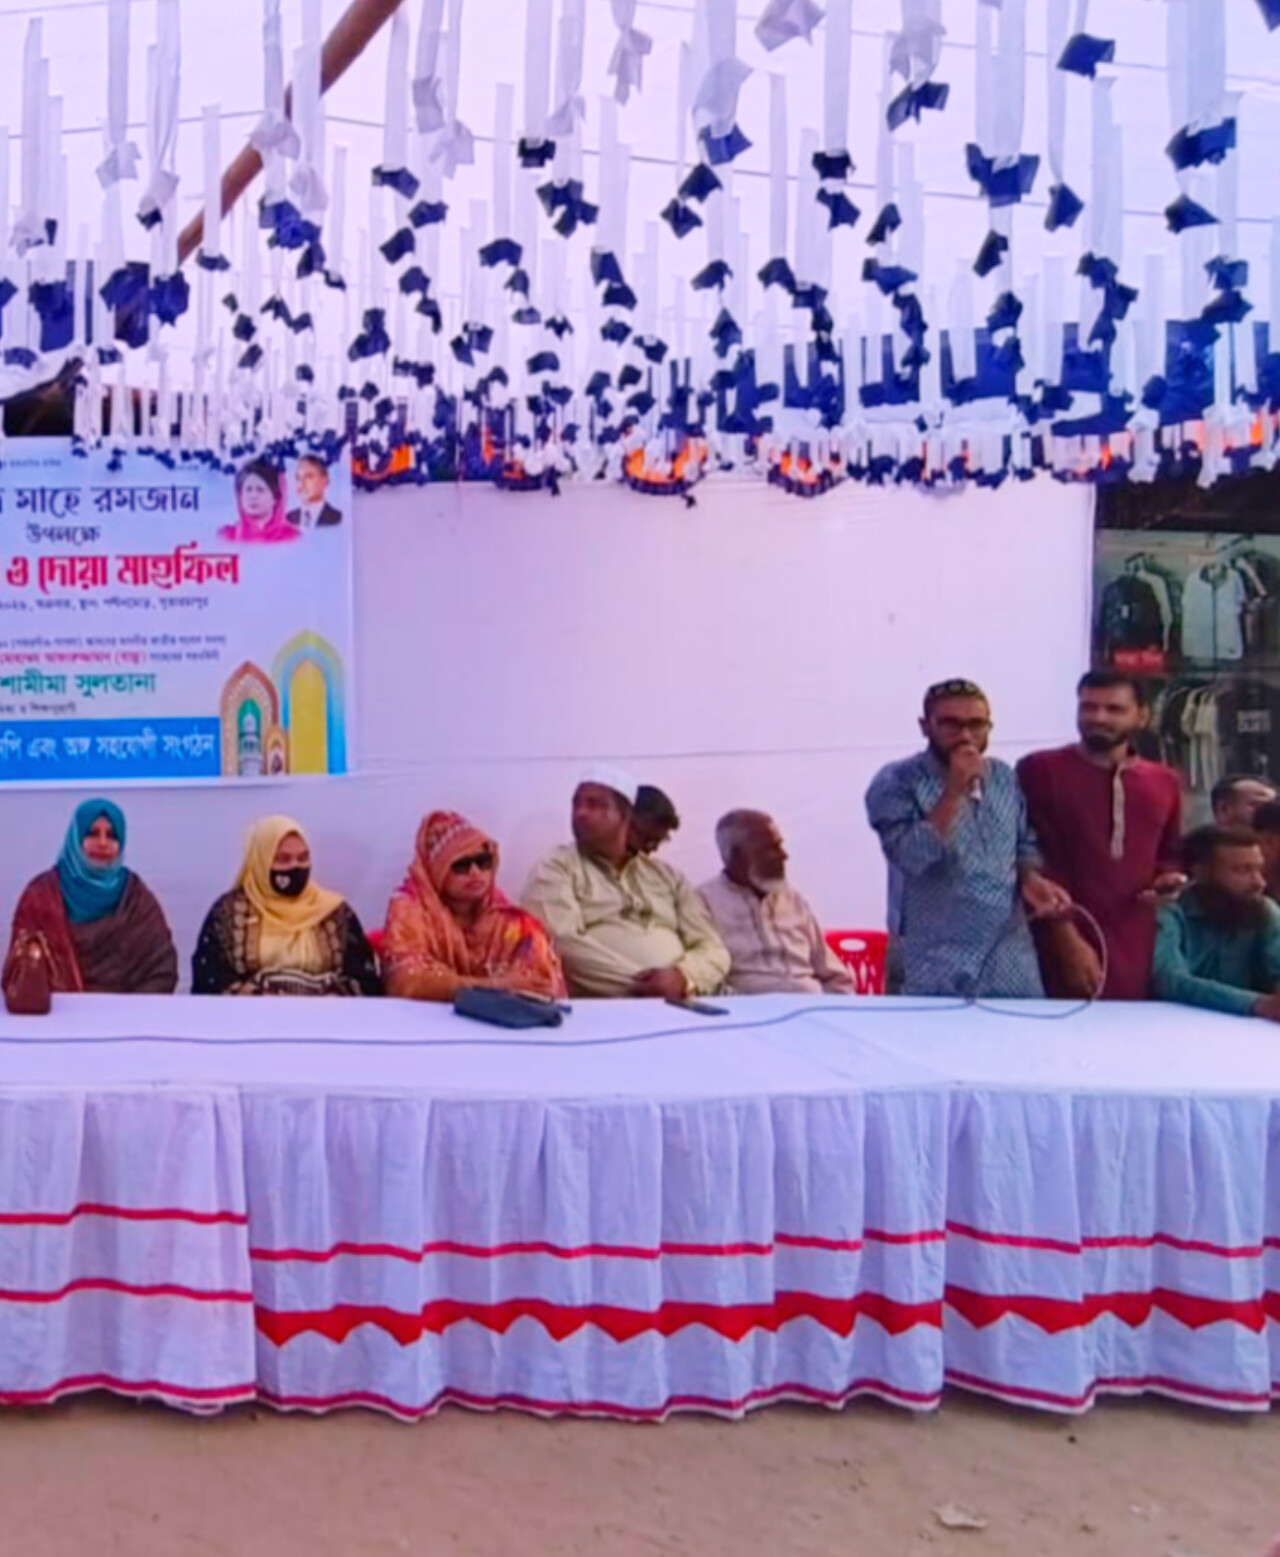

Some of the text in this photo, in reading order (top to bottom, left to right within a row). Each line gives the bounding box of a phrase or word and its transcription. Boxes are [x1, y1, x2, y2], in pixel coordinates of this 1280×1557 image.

[15, 485, 81, 516] মাহে
[90, 484, 199, 514] রমজান
[26, 523, 100, 545] উপলক্ষে
[6, 555, 28, 586] ও
[38, 553, 108, 594] দোয়া
[117, 541, 239, 589] মাহফিল
[75, 672, 156, 698] সুলতানা
[27, 736, 60, 763] এবং
[162, 724, 215, 761] সংগঠন
